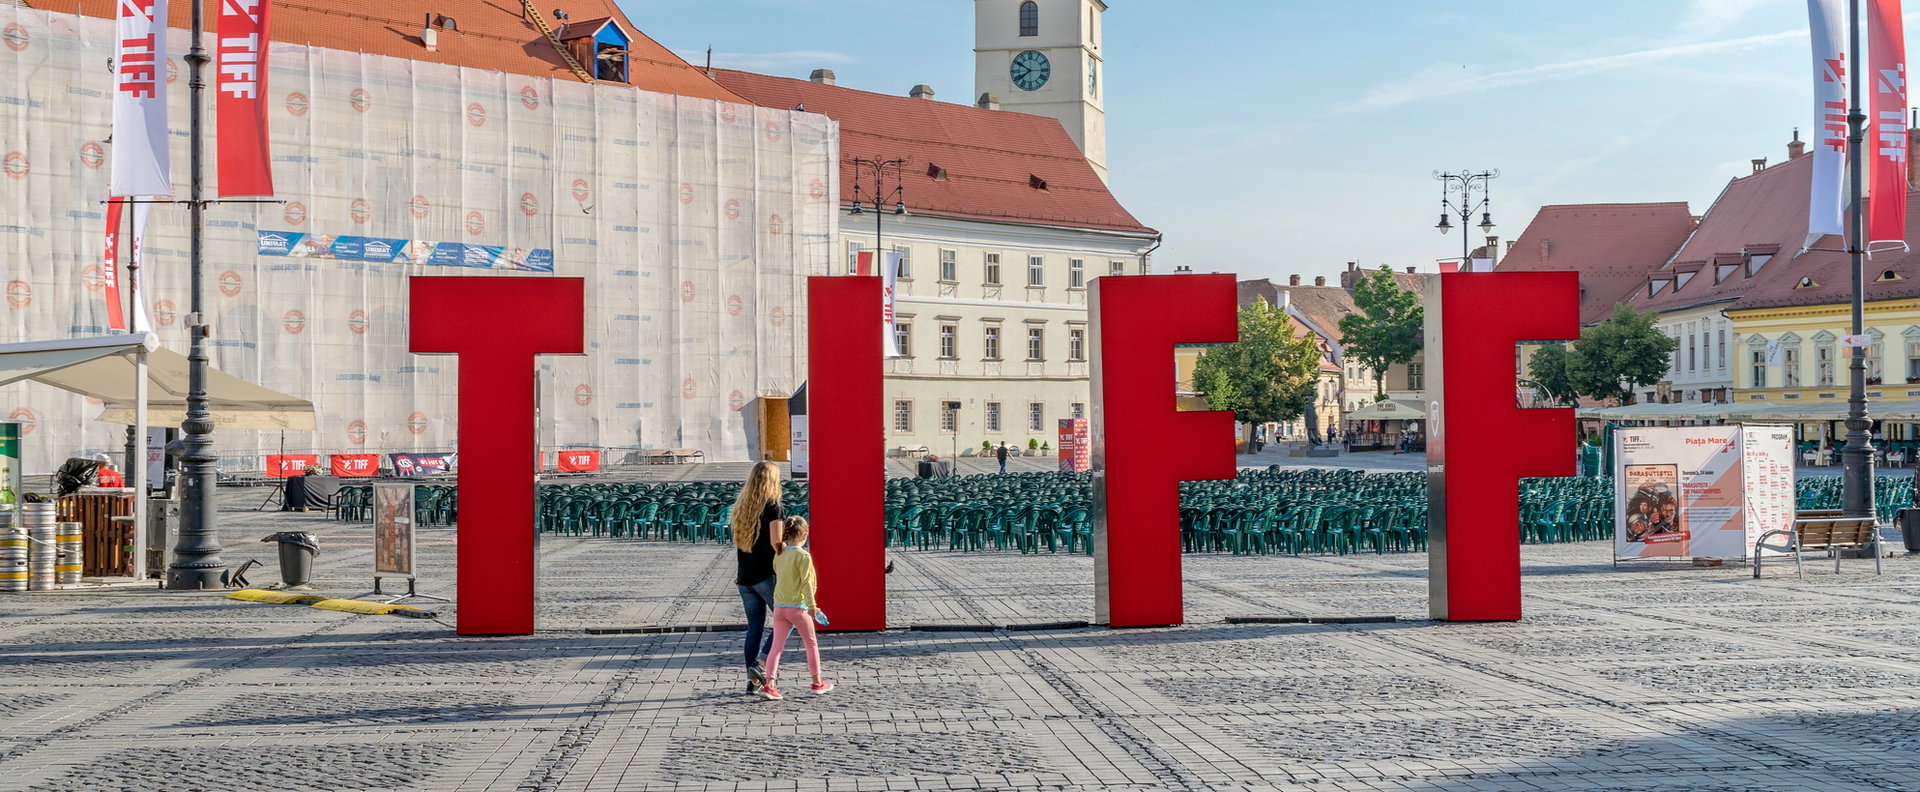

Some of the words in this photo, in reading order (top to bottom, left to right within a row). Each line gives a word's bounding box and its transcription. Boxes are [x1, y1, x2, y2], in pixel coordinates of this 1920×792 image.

[120, 33, 156, 99] TIFF
[221, 33, 258, 99] TIFF
[1824, 98, 1846, 153] TIFF
[1879, 107, 1906, 162] TIFF
[104, 257, 115, 288] TIFF
[410, 272, 1580, 636] TIFF
[579, 455, 591, 465] TIFF
[1685, 438, 1706, 446] Piața
[291, 460, 306, 470] TIFF
[354, 459, 369, 470] TIFF
